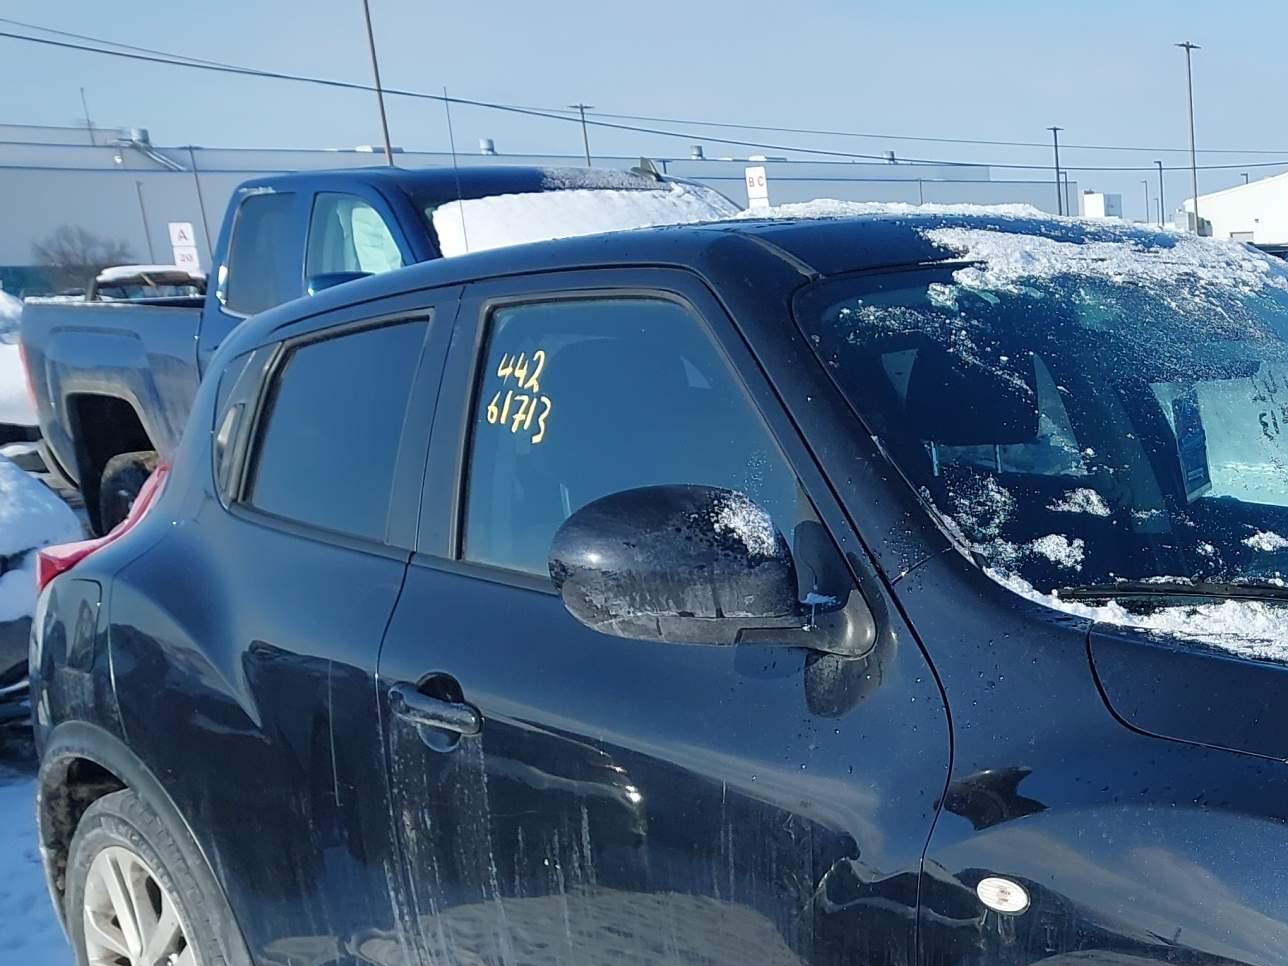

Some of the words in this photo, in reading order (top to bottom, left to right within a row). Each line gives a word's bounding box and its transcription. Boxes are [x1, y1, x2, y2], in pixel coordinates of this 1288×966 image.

[177, 229, 188, 241] A
[497, 350, 545, 393] 442
[487, 390, 552, 444] 61713
